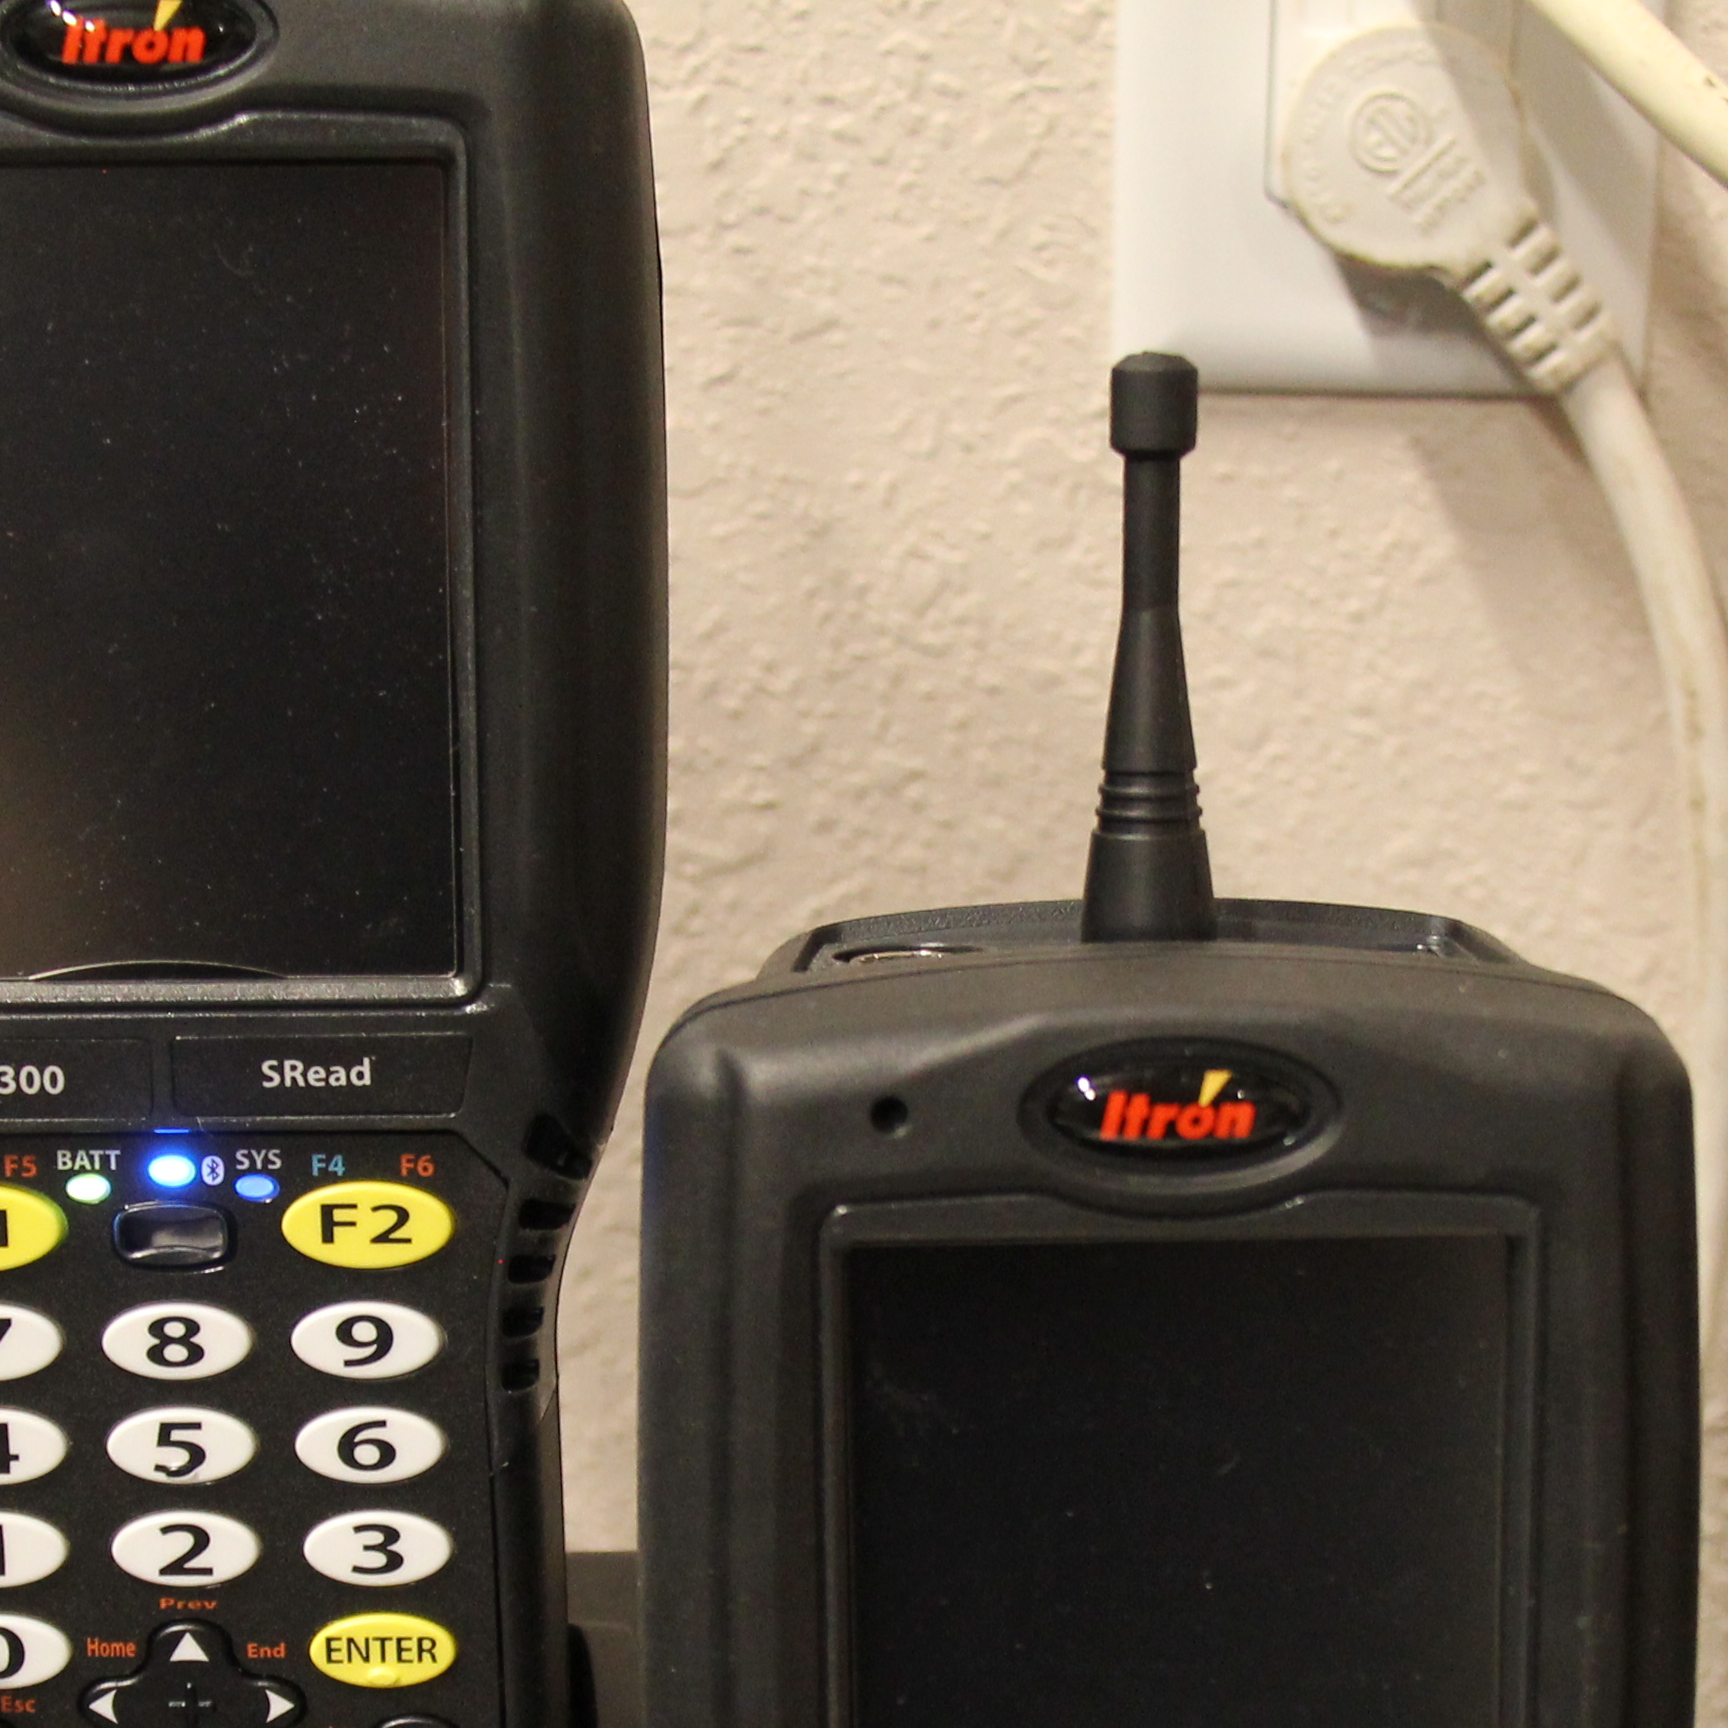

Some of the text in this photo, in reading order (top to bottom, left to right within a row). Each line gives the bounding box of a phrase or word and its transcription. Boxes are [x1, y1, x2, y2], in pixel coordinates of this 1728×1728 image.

[61, 15, 206, 65] Itron
[261, 1057, 372, 1088] SRead
[1099, 1090, 1256, 1141] Itron
[4, 1155, 37, 1178] F5
[57, 1149, 121, 1171] BATT
[235, 1149, 282, 1170] SYS
[311, 1154, 345, 1177] F4
[400, 1154, 434, 1177] F6
[320, 1203, 413, 1245] F2
[146, 1315, 206, 1368] 8
[335, 1314, 395, 1368] 9
[153, 1421, 207, 1479] 5
[337, 1419, 397, 1472] 6
[158, 1523, 214, 1577] 2
[351, 1523, 405, 1576] 3
[86, 1638, 136, 1658] Home
[247, 1642, 286, 1658] End
[325, 1636, 437, 1664] ENTER
